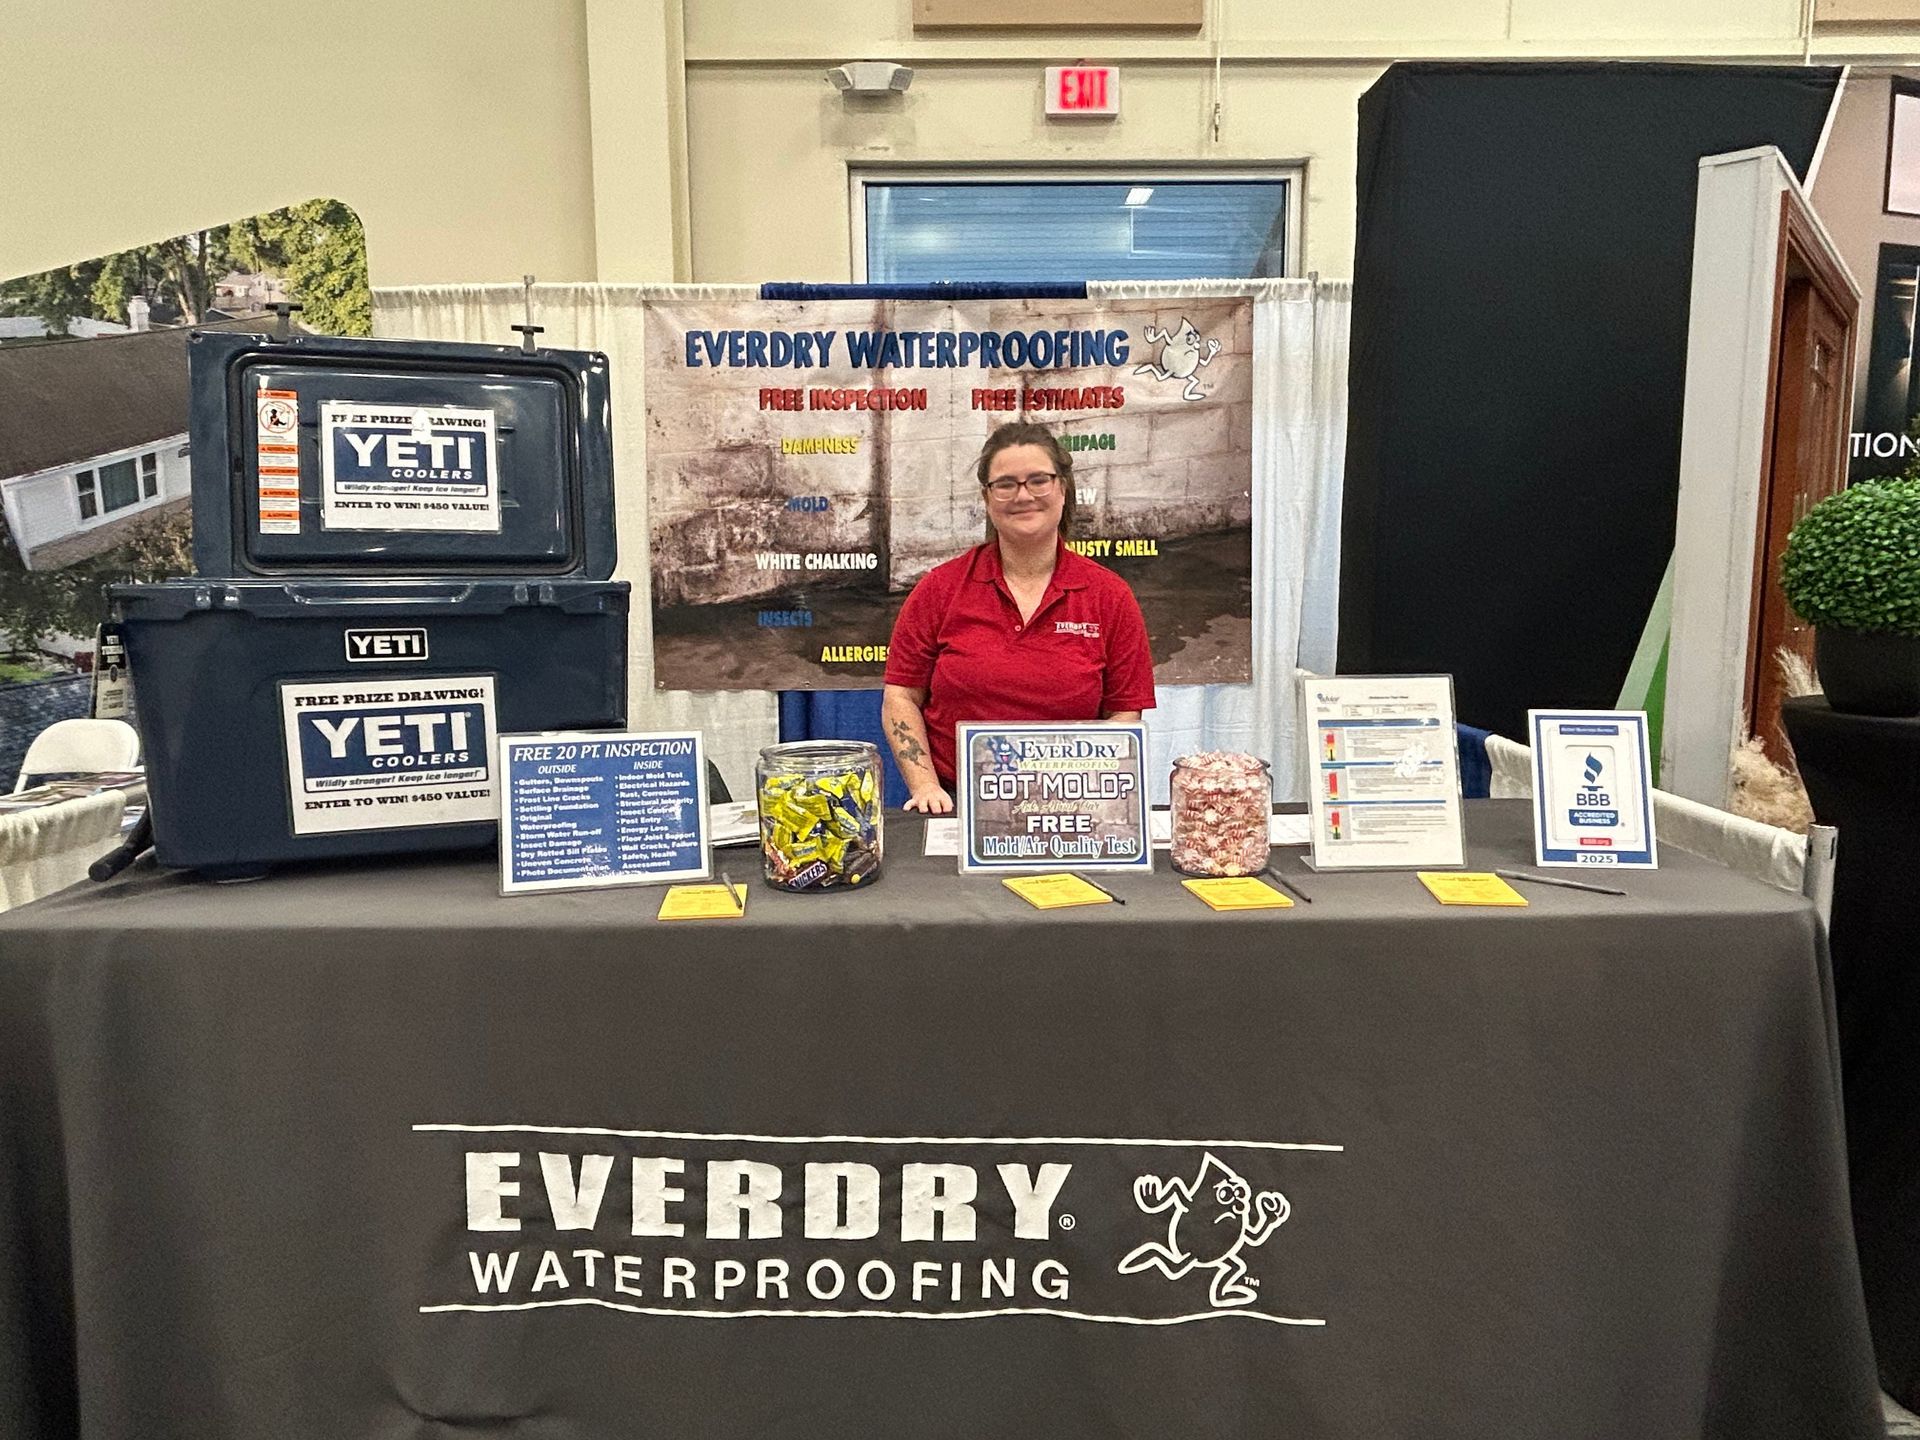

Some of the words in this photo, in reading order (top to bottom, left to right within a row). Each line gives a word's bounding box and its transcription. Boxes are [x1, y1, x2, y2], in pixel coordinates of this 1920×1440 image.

[1059, 69, 1108, 110] EXIT
[685, 330, 836, 368] EVERDRY
[846, 330, 1129, 369] WATERPROOFING
[759, 388, 804, 411] FREE
[809, 388, 927, 411] INSPECTION
[971, 389, 1016, 411] FREE
[1022, 386, 1125, 411] ESTIMATES
[370, 415, 412, 425] PRIZE
[427, 417, 487, 428] RAWING!
[781, 437, 858, 455] DAMPNESS
[1851, 432, 1919, 458] TION
[344, 433, 472, 470] YETI
[391, 468, 473, 480] COOLERS
[344, 484, 370, 492] Wildly
[412, 486, 433, 494] Keep
[334, 501, 373, 509] ENTER
[423, 502, 449, 510] $450
[451, 503, 490, 511] VALUE!
[786, 496, 829, 512] MOLD
[1115, 540, 1159, 557] SMELL
[755, 553, 801, 570] WHITE
[804, 553, 878, 570] CHALKING
[757, 610, 814, 628] INSECTS
[351, 635, 421, 655] YETI
[295, 694, 339, 707] FREE
[343, 692, 394, 704] PRIZE
[397, 688, 485, 702] DRAWING!
[311, 711, 471, 759] YETI
[514, 746, 554, 762] FREE
[555, 745, 577, 760] 20
[580, 744, 602, 759] PT.
[604, 741, 693, 757] INSPECTION
[371, 751, 469, 768] COOLERS
[633, 760, 664, 770] INSIDE
[1020, 760, 1118, 769] WATERPROOFING
[537, 764, 577, 774] OUTSIDE
[315, 779, 347, 788] Wildly
[349, 775, 396, 786] stronger!
[398, 773, 423, 784] Keep
[425, 772, 441, 781] ice
[443, 769, 477, 780] longer!
[519, 778, 553, 786] Gutters,
[519, 787, 551, 795] Surface
[553, 785, 590, 794] Drainage
[619, 782, 658, 790] Electrical
[659, 780, 691, 788] Hazards
[979, 773, 1036, 800] GOT
[1042, 772, 1136, 801] MOLD?
[304, 798, 351, 810] ENTER
[353, 797, 374, 807] TO
[376, 795, 409, 805] WIN!
[411, 792, 443, 803] $450
[445, 788, 491, 800] VALUE!
[519, 796, 541, 804] Frost
[562, 793, 591, 801] Cracks
[642, 789, 679, 797] Corrosion
[620, 798, 659, 808] Structural
[1576, 793, 1611, 806] BBB
[519, 804, 552, 813] Settling
[554, 802, 600, 811] Foundation
[620, 808, 646, 816] Insect
[646, 805, 681, 815] Contro
[520, 813, 552, 822] Original
[640, 816, 661, 824] Entry
[1027, 814, 1092, 833] FREE
[519, 821, 577, 831] Waterproofing
[621, 826, 649, 834] Energy
[520, 832, 545, 840] Storm
[546, 831, 571, 839] Water
[572, 828, 602, 837] Run-off
[621, 835, 641, 843] Floor
[643, 833, 663, 841] Joist
[664, 832, 696, 841] Support
[548, 840, 582, 848] Damage
[671, 840, 699, 849] Failure
[984, 836, 1047, 856] Mold/Air
[1051, 835, 1102, 858] Quality
[1105, 835, 1136, 854] Test
[520, 851, 535, 859] Dry
[537, 849, 564, 858] Rotted
[566, 847, 579, 855] Sill
[651, 850, 678, 859] Health
[1581, 854, 1614, 864] 2025
[520, 860, 552, 868] Uneven
[622, 860, 671, 869] Assessment
[521, 868, 546, 877] Photo
[468, 1249, 1070, 1301] WATERPROOFING
